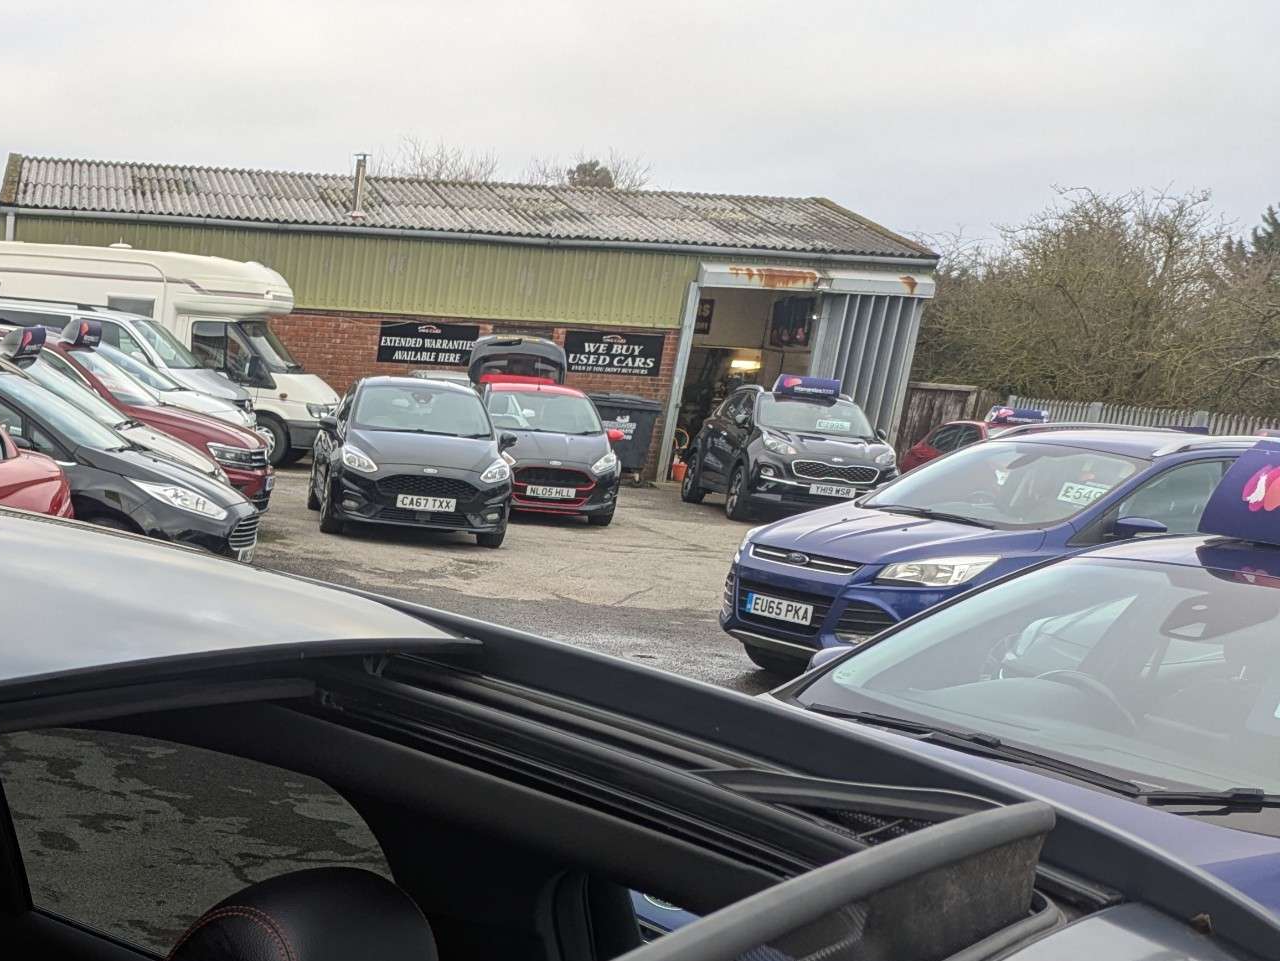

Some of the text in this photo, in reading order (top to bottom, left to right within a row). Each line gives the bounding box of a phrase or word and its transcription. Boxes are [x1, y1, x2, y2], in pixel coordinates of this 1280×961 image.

[380, 336, 477, 351] EXTENDED WARRANTIES
[584, 342, 644, 355] WE BUY
[393, 350, 461, 363] AVAILABLE HERE
[568, 353, 656, 368] USED CARS
[401, 496, 451, 510] CA67 TXX
[753, 596, 809, 622] EU65 PKA
